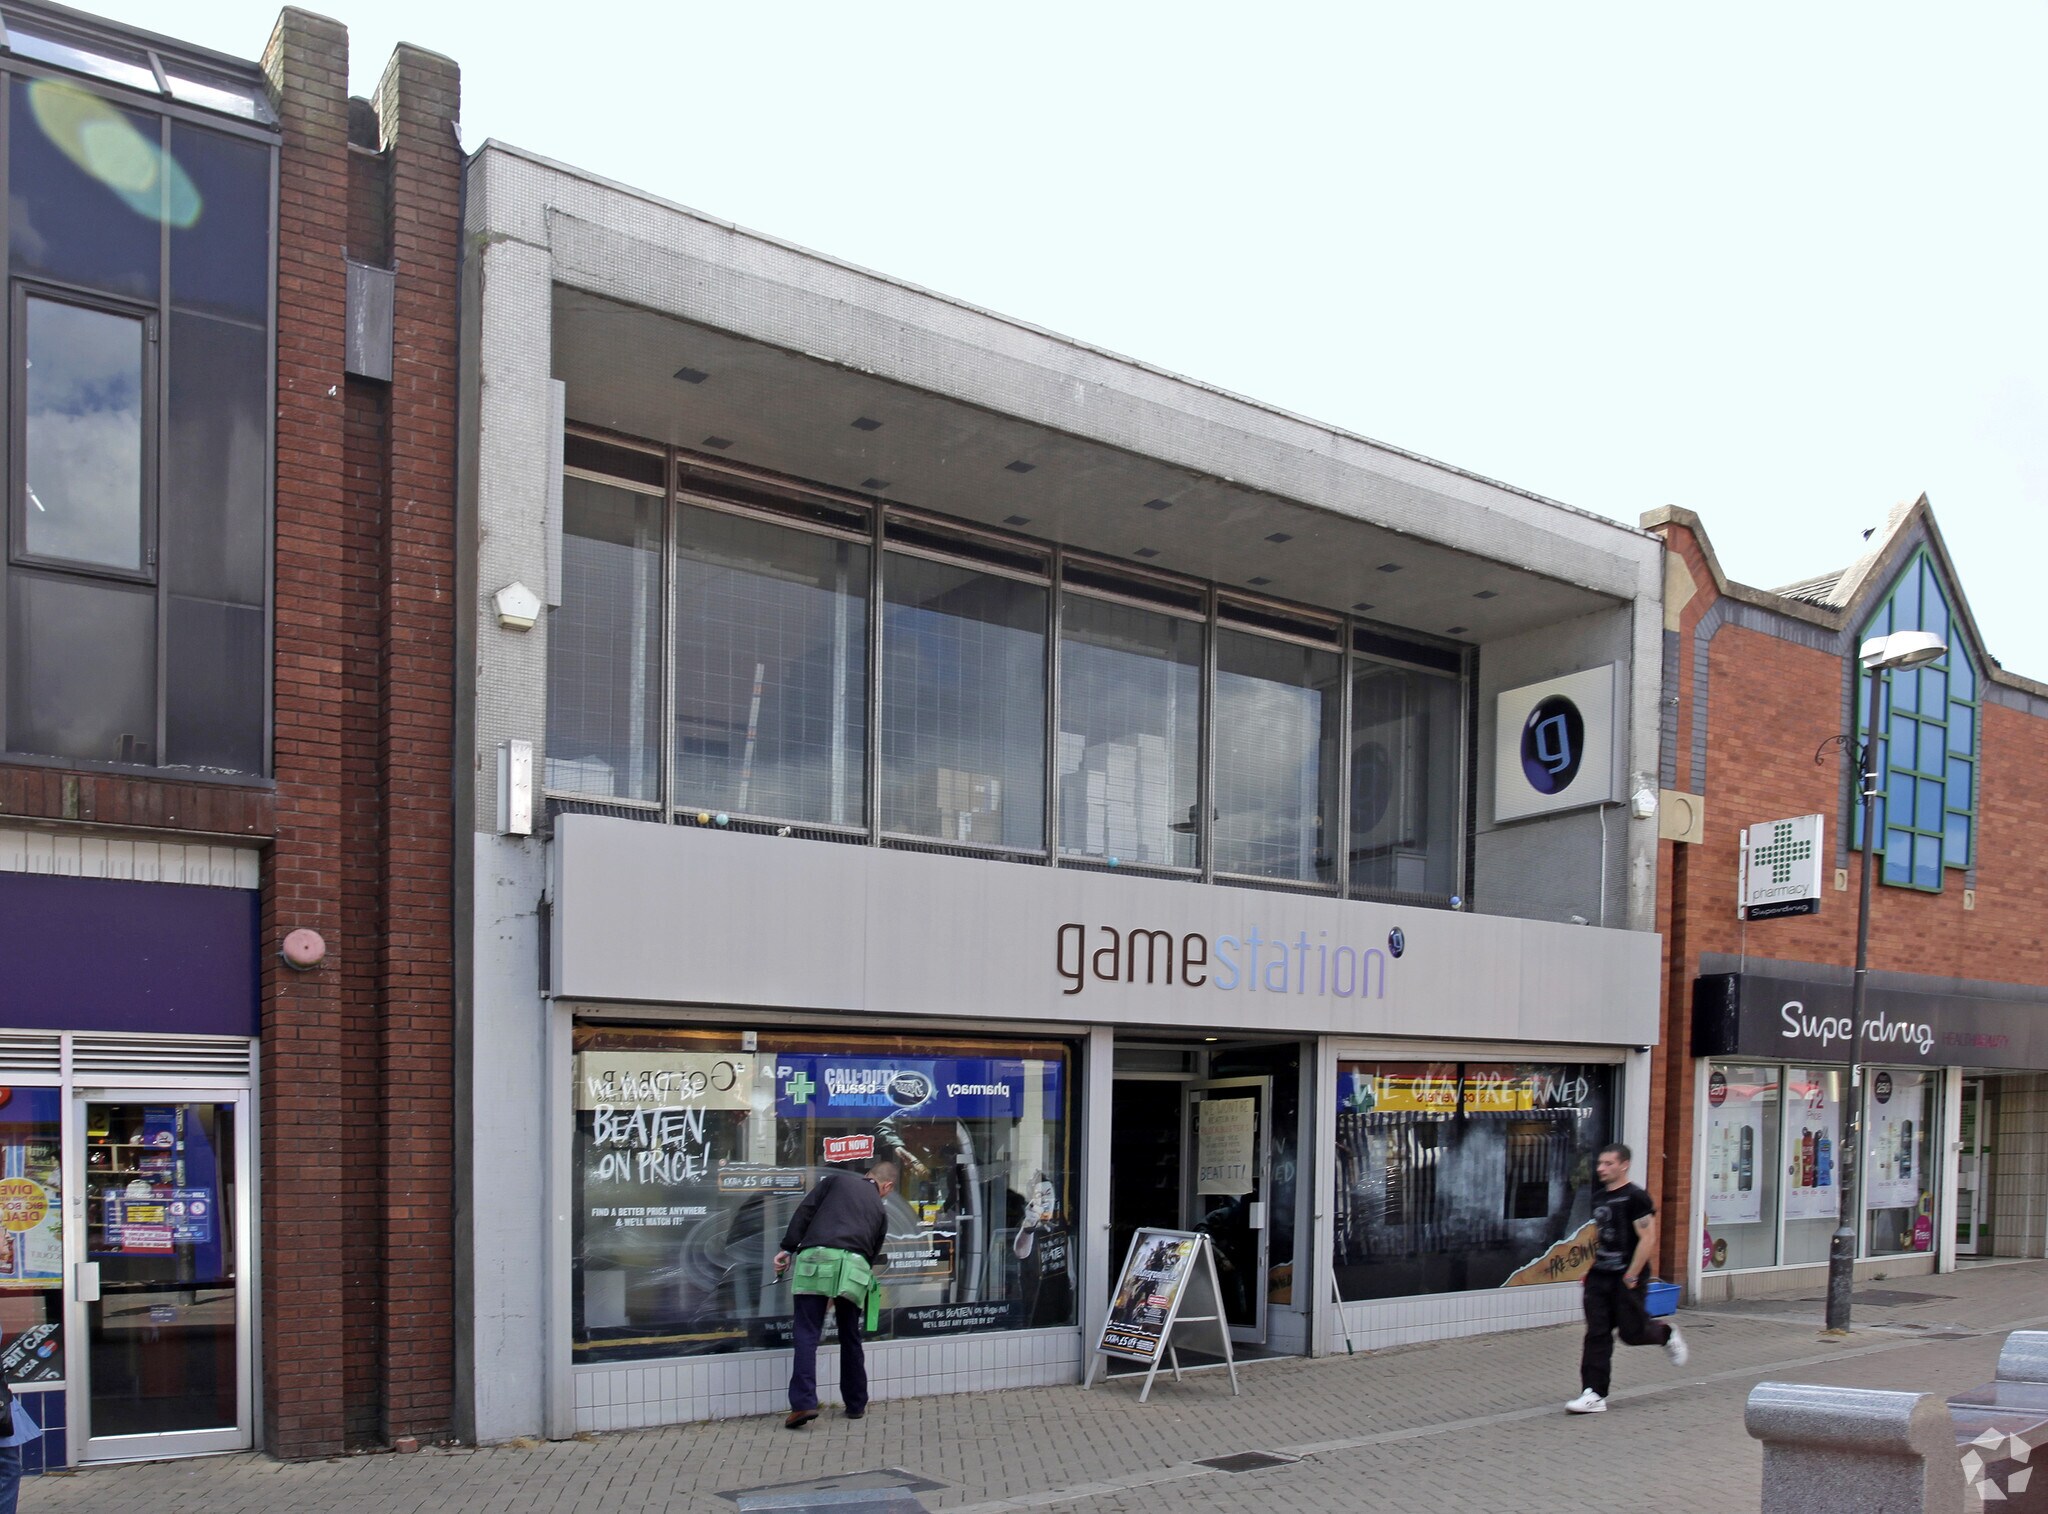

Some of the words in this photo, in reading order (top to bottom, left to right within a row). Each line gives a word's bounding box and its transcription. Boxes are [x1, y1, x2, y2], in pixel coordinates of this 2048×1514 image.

[1535, 713, 1571, 775] g
[1752, 884, 1810, 903] pharmacy
[1751, 904, 1809, 917] Superdrug
[1056, 922, 1386, 999] gamestation
[1781, 1001, 1935, 1055] Superdrug
[824, 1068, 859, 1085] CALL
[681, 1078, 706, 1101] BE
[592, 1104, 707, 1150] BEATEN
[829, 1141, 847, 1153] OUT
[848, 1138, 870, 1151] NOW!
[599, 1150, 632, 1184] ON
[638, 1142, 711, 1185] PRICE!
[743, 1175, 757, 1187] £5
[1200, 1165, 1225, 1182] BEAT
[591, 1208, 610, 1217] FIND
[610, 1208, 617, 1216] A
[618, 1207, 645, 1216] BETTER
[646, 1207, 668, 1216] PRICE
[668, 1206, 707, 1215] ANYWHERE
[645, 1217, 671, 1226] MATCH
[886, 1251, 903, 1260] WHEN
[904, 1250, 915, 1260] YOU
[915, 1249, 941, 1259] TRADE-IN
[895, 1260, 922, 1269] SELECTED
[922, 1259, 938, 1268] GAME
[945, 1306, 973, 1319] BEATEN
[938, 1319, 951, 1328] BEAT
[951, 1319, 962, 1327] ANY
[962, 1318, 979, 1326] OFFER
[13, 1358, 40, 1378] VISA
